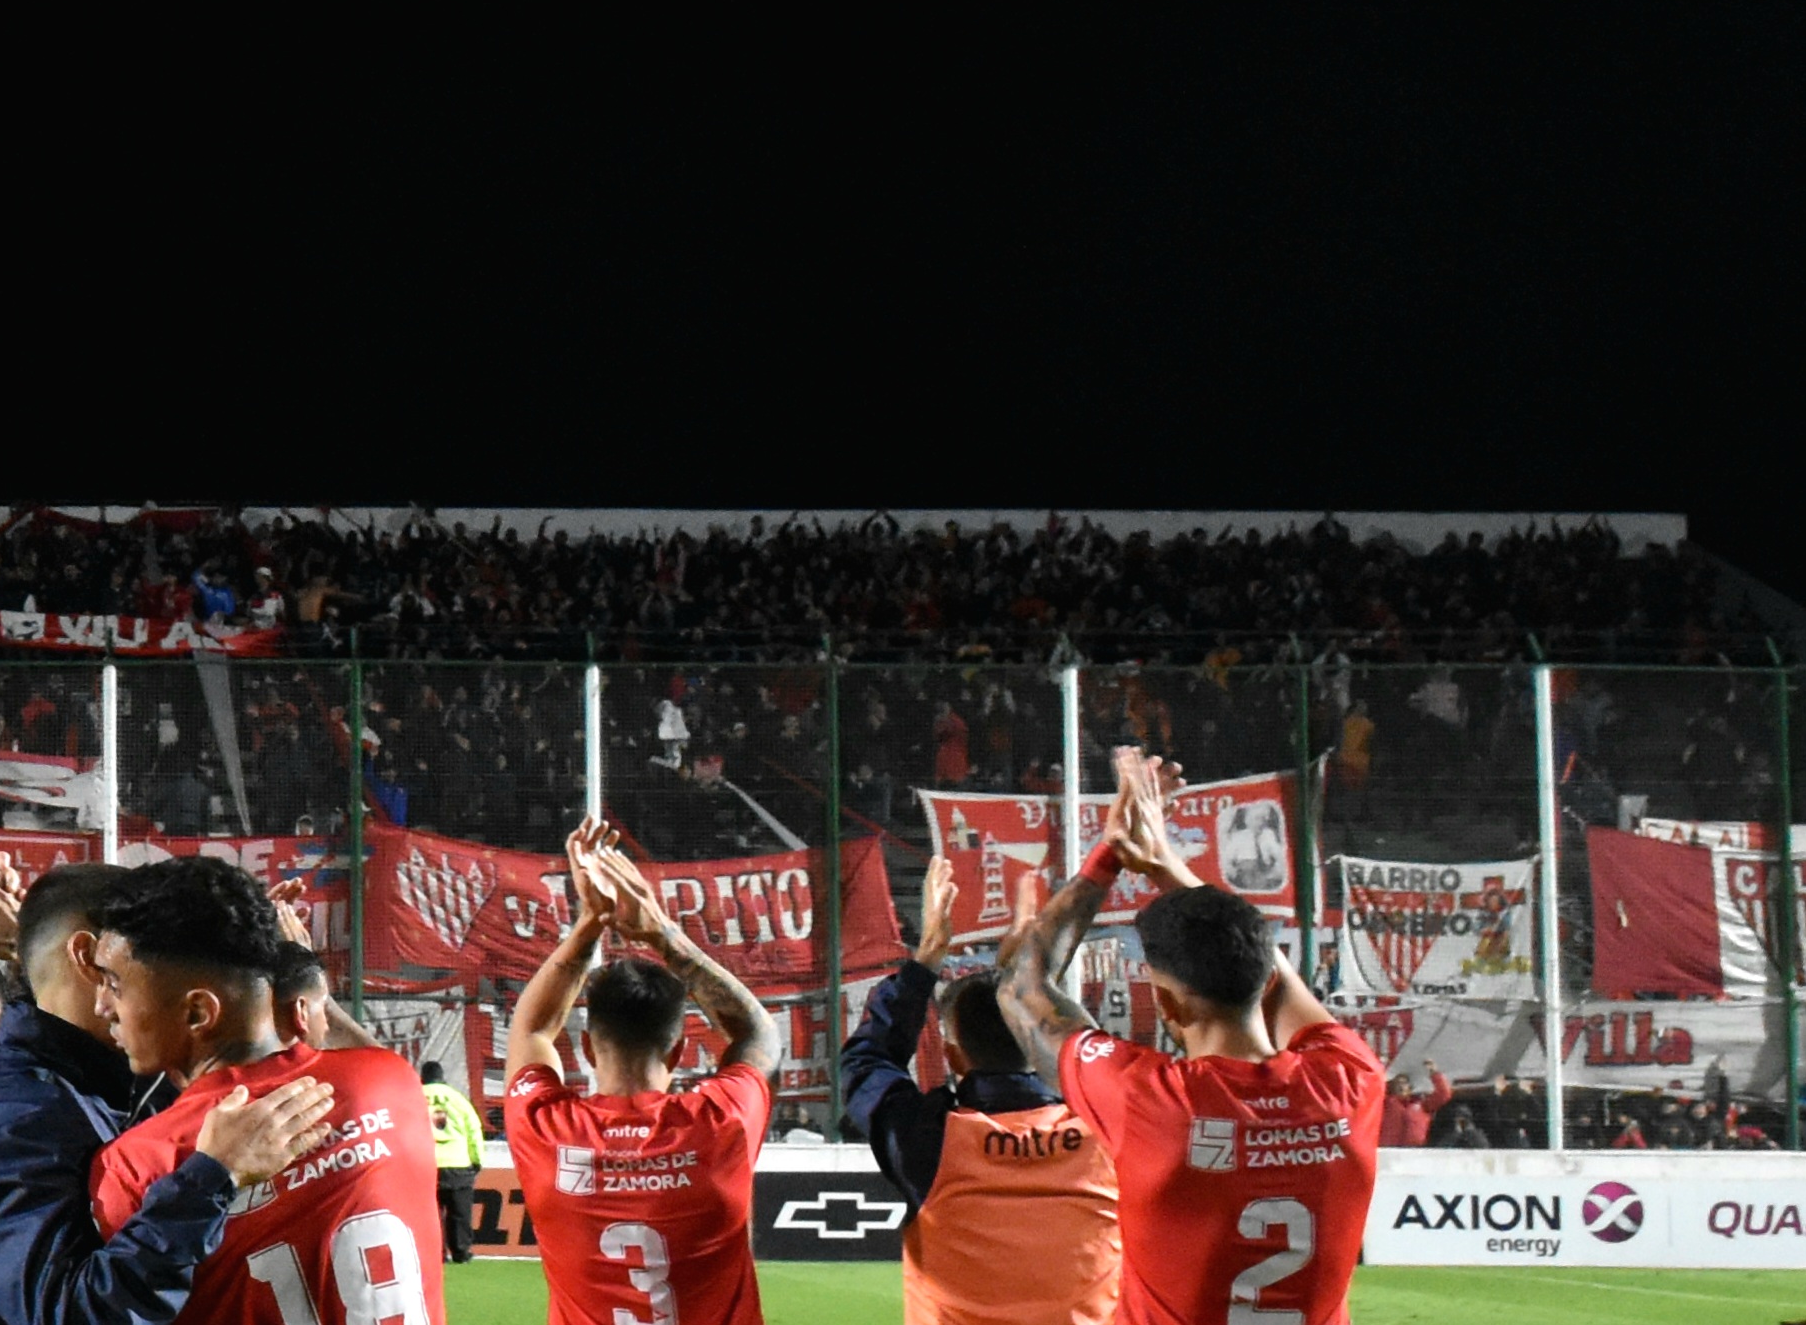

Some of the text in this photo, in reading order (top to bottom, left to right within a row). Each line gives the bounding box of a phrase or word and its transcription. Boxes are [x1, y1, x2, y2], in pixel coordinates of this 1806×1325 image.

[1347, 863, 1461, 892] BARRIO
[1530, 1010, 1695, 1066] Villa
[362, 1108, 394, 1133] DE
[602, 1123, 650, 1139] mitre
[1244, 1117, 1352, 1146] LOMAS DE
[983, 1124, 1083, 1160] mitre
[1245, 1142, 1346, 1168] ZAMORA
[283, 1139, 392, 1191] ZAMORA
[602, 1150, 698, 1174] LOMAS DE
[602, 1171, 692, 1193] ZAMORA
[1391, 1193, 1562, 1231] AXION
[1486, 1237, 1562, 1258] energy
